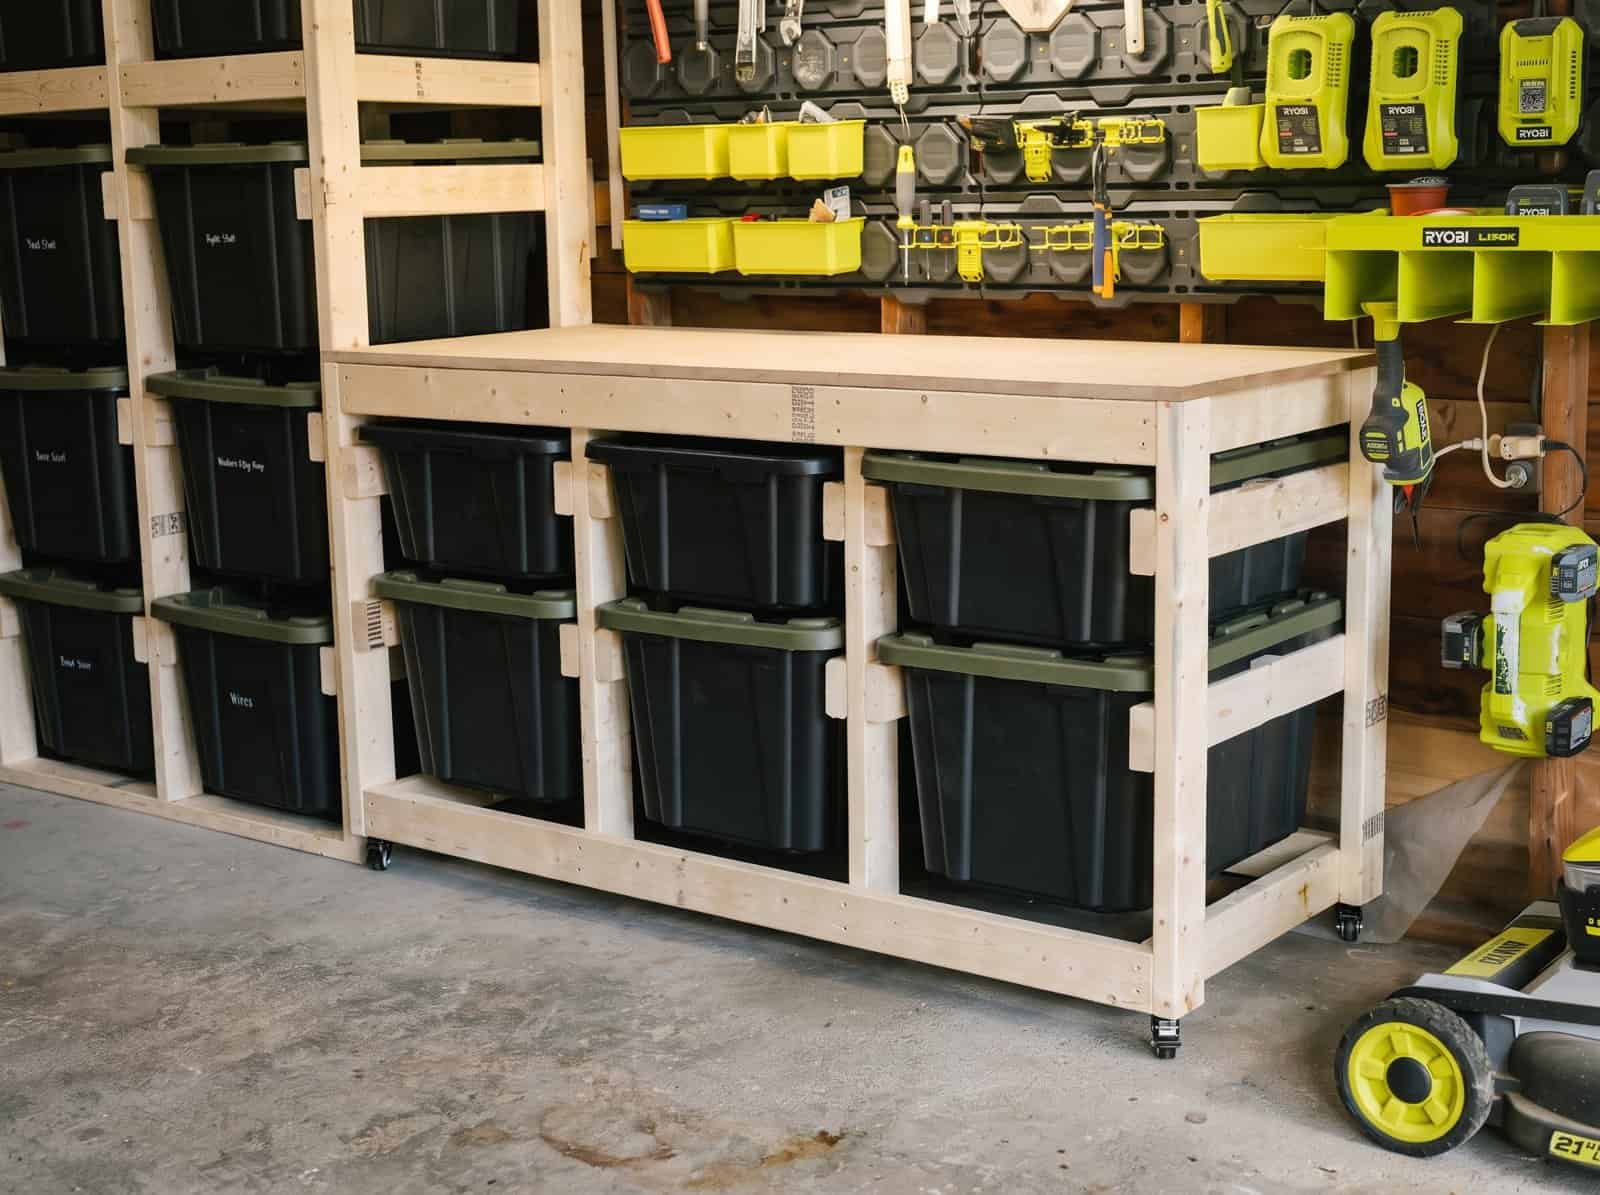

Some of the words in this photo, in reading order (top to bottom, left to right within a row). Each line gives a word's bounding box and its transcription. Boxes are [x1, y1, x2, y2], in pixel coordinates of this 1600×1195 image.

[1283, 107, 1308, 115] RYOBI
[1388, 106, 1415, 115] RYOBI
[1519, 128, 1549, 138] RYOBI
[1424, 231, 1469, 244] RYOBI
[1416, 400, 1427, 441] RYOBI
[229, 691, 254, 708] Wires
